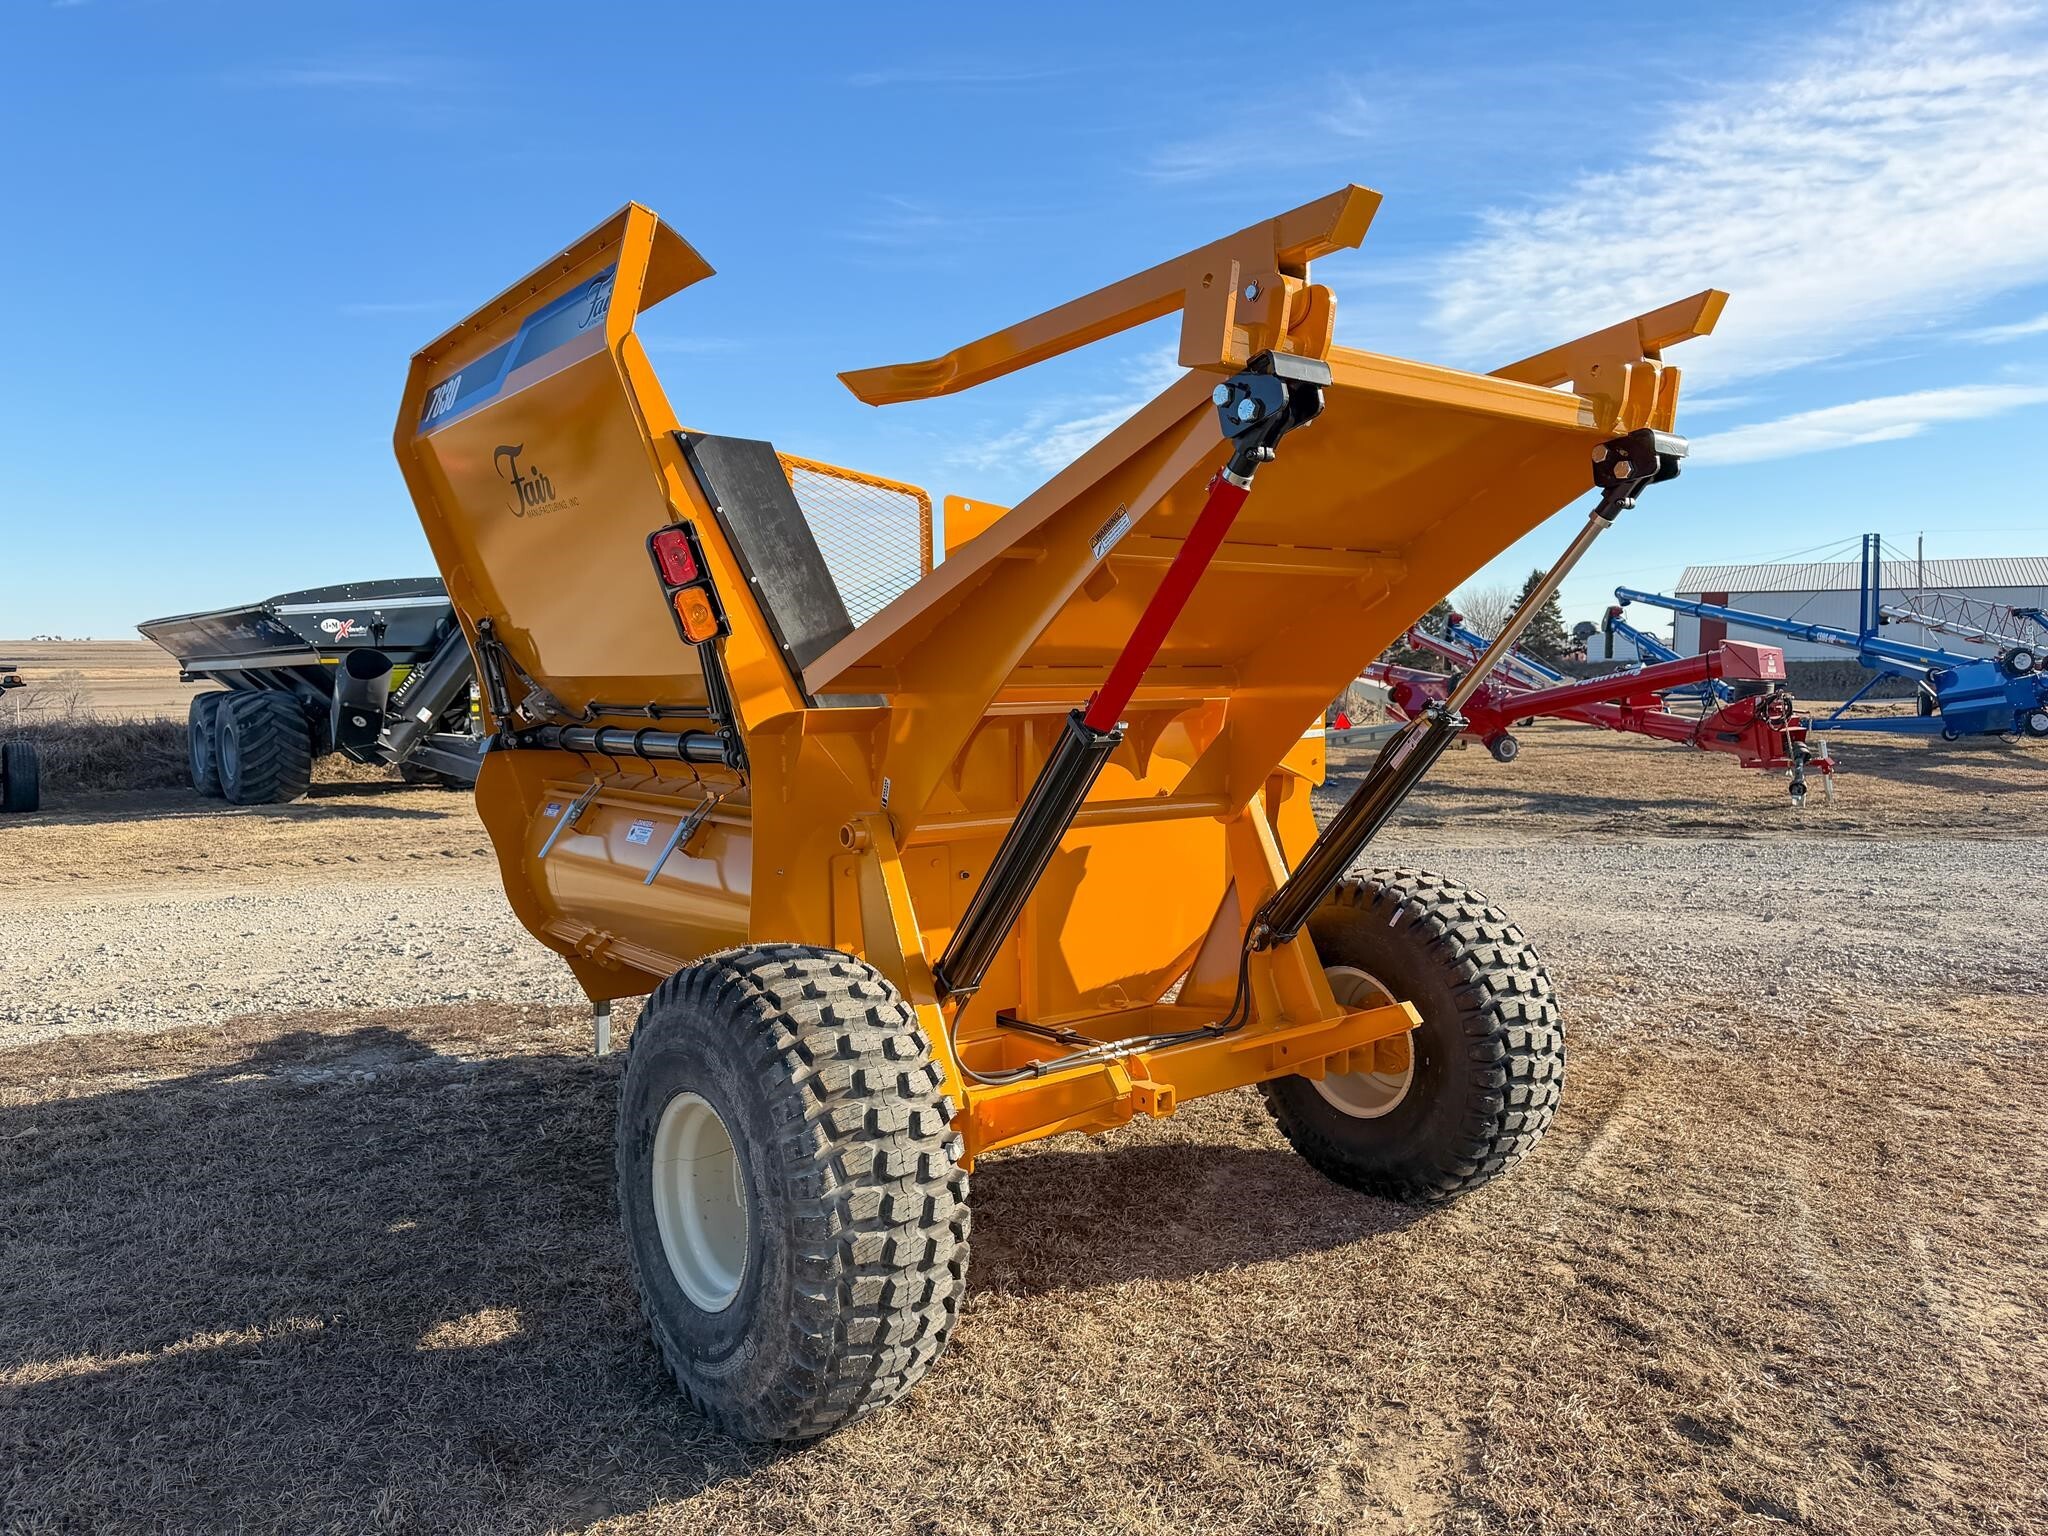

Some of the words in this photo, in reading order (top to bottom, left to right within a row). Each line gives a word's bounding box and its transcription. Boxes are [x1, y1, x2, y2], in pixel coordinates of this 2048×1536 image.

[579, 271, 615, 328] Fai
[425, 375, 462, 423] 7830
[494, 443, 556, 518] Fair
